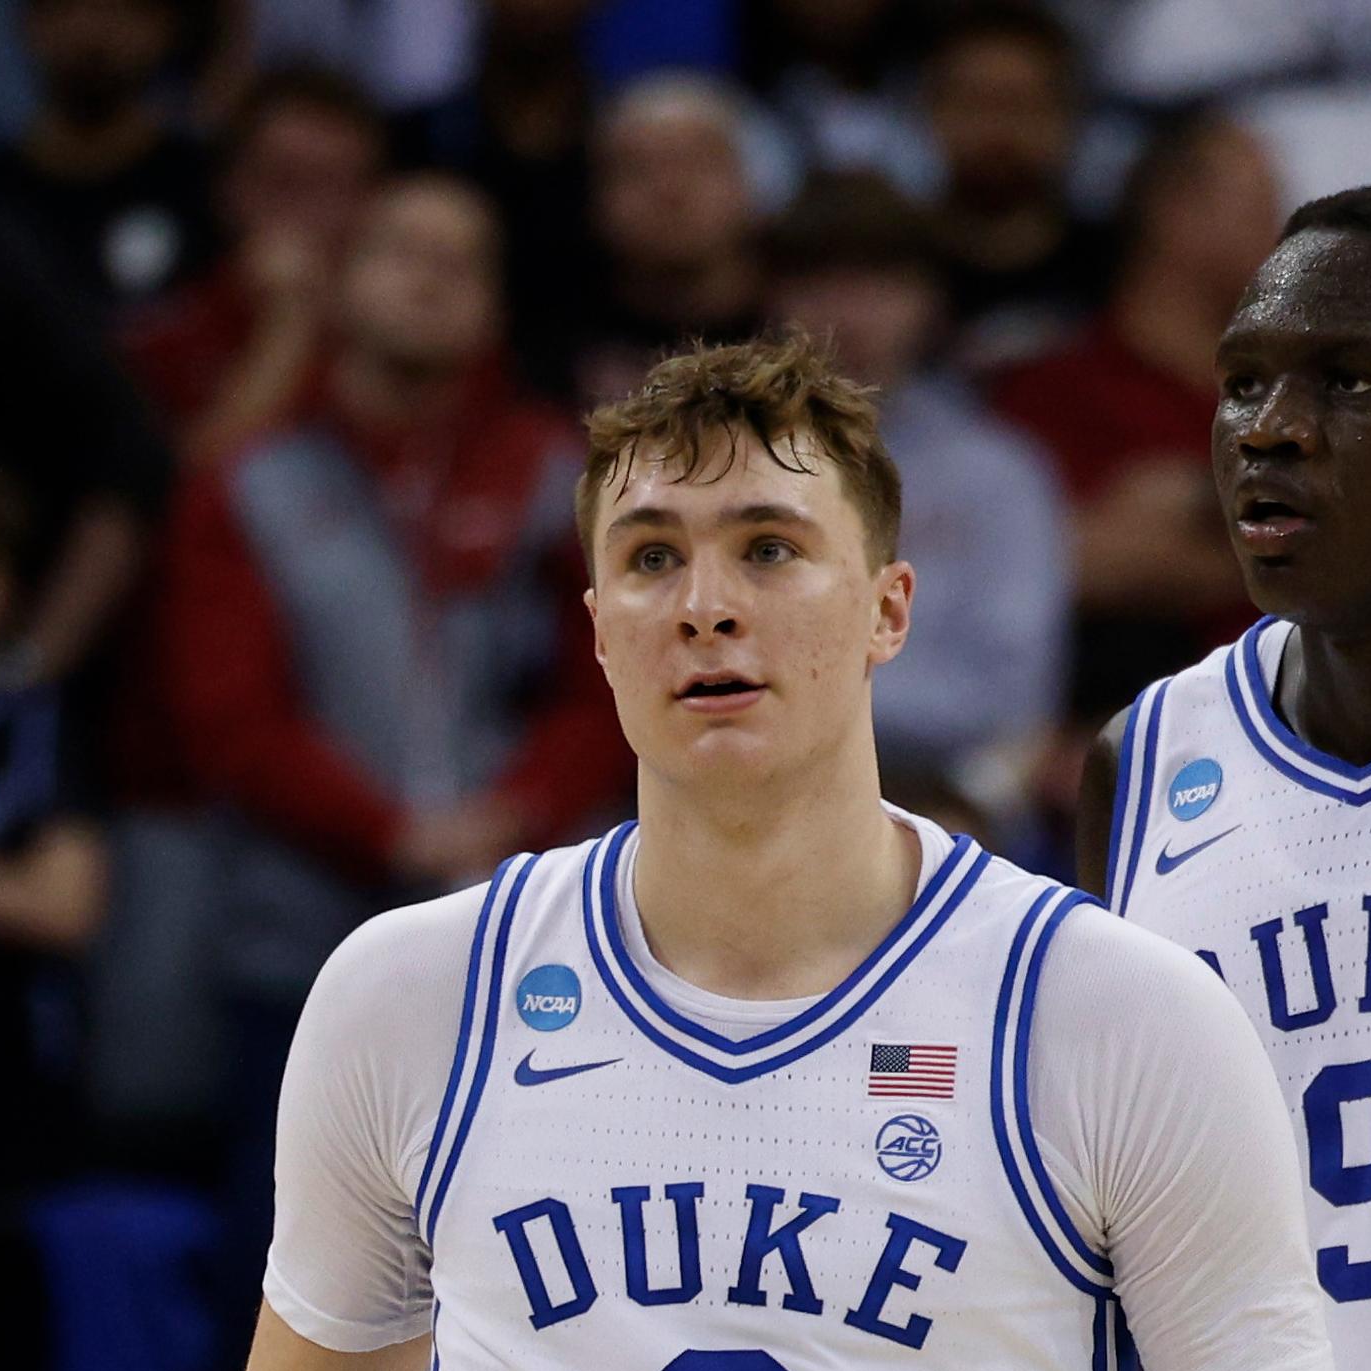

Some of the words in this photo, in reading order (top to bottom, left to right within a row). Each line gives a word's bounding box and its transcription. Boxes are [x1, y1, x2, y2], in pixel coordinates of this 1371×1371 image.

[1172, 782, 1217, 808] NCAA
[522, 993, 577, 1015] NCAA
[882, 1136, 940, 1155] ACC
[491, 1181, 968, 1350] DUKE
